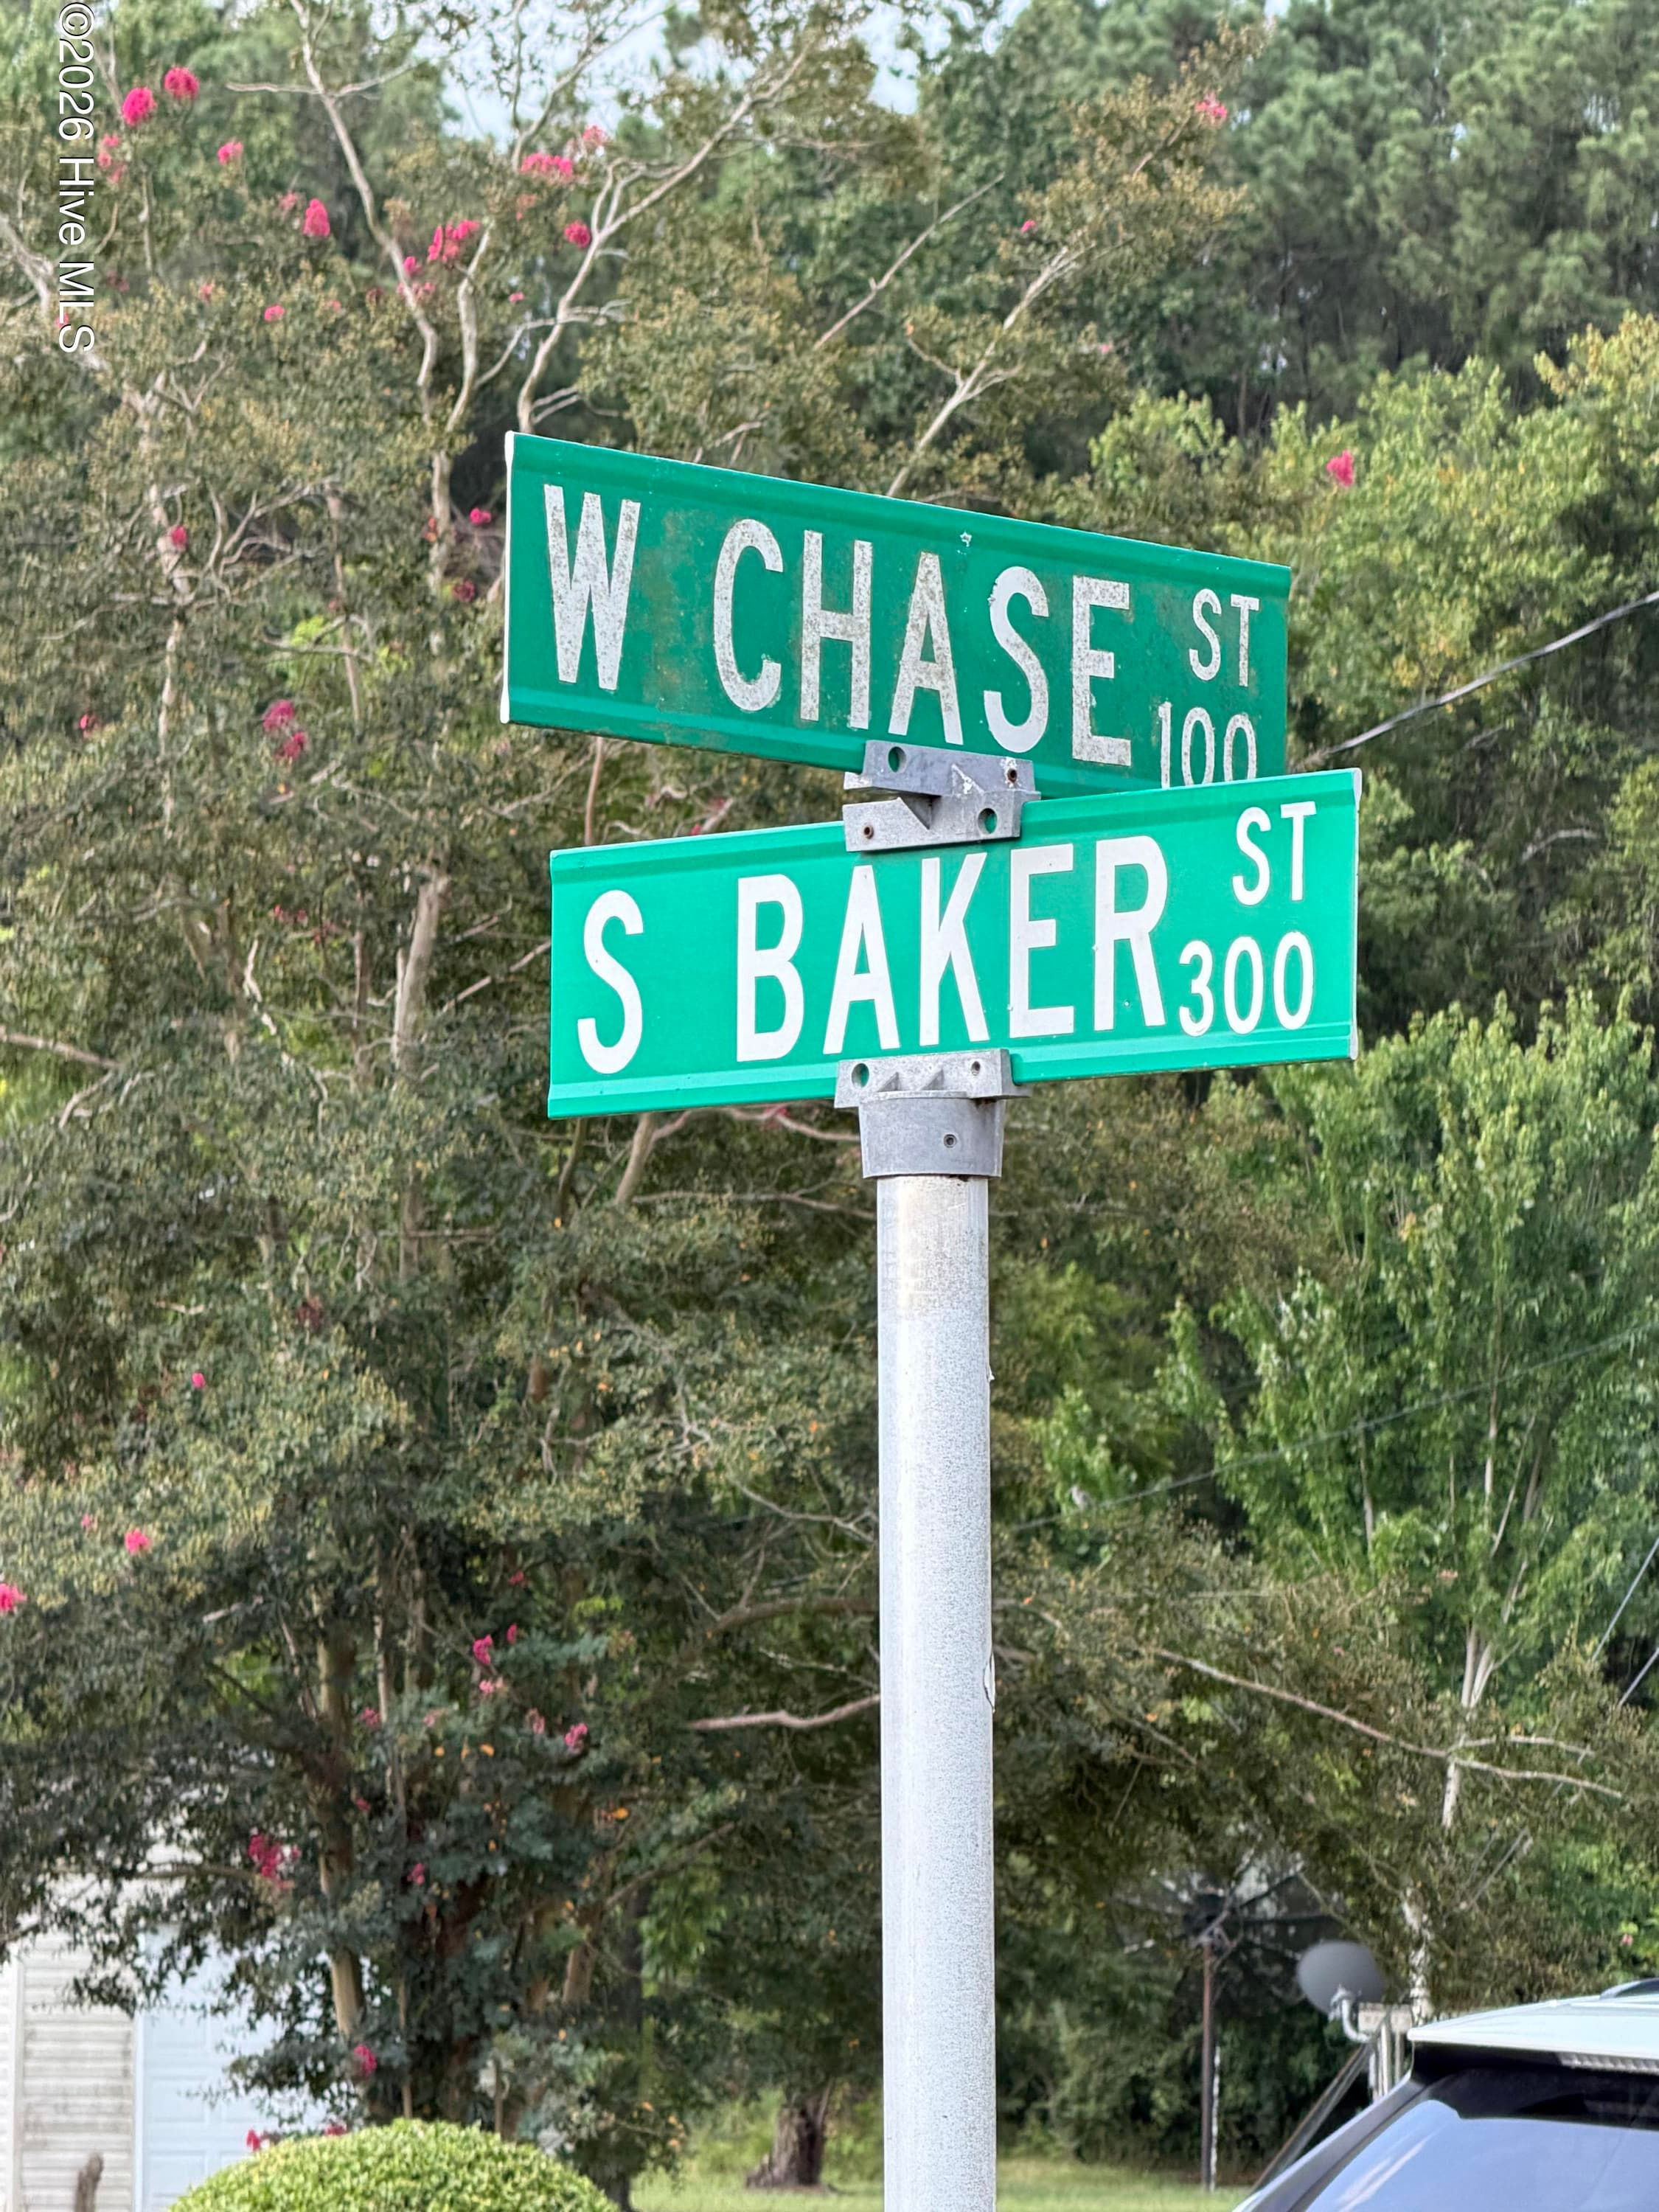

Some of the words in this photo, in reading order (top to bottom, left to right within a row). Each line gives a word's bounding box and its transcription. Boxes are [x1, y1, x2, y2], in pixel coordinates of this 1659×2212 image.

[543, 484, 641, 691] W
[713, 518, 1132, 767] CHASE
[1189, 588, 1260, 687] ST
[1158, 701, 1257, 790] 100
[1232, 801, 1317, 906] ST
[577, 889, 644, 1074] S
[737, 835, 1169, 1062] BAKER
[1179, 931, 1315, 1037] 300
